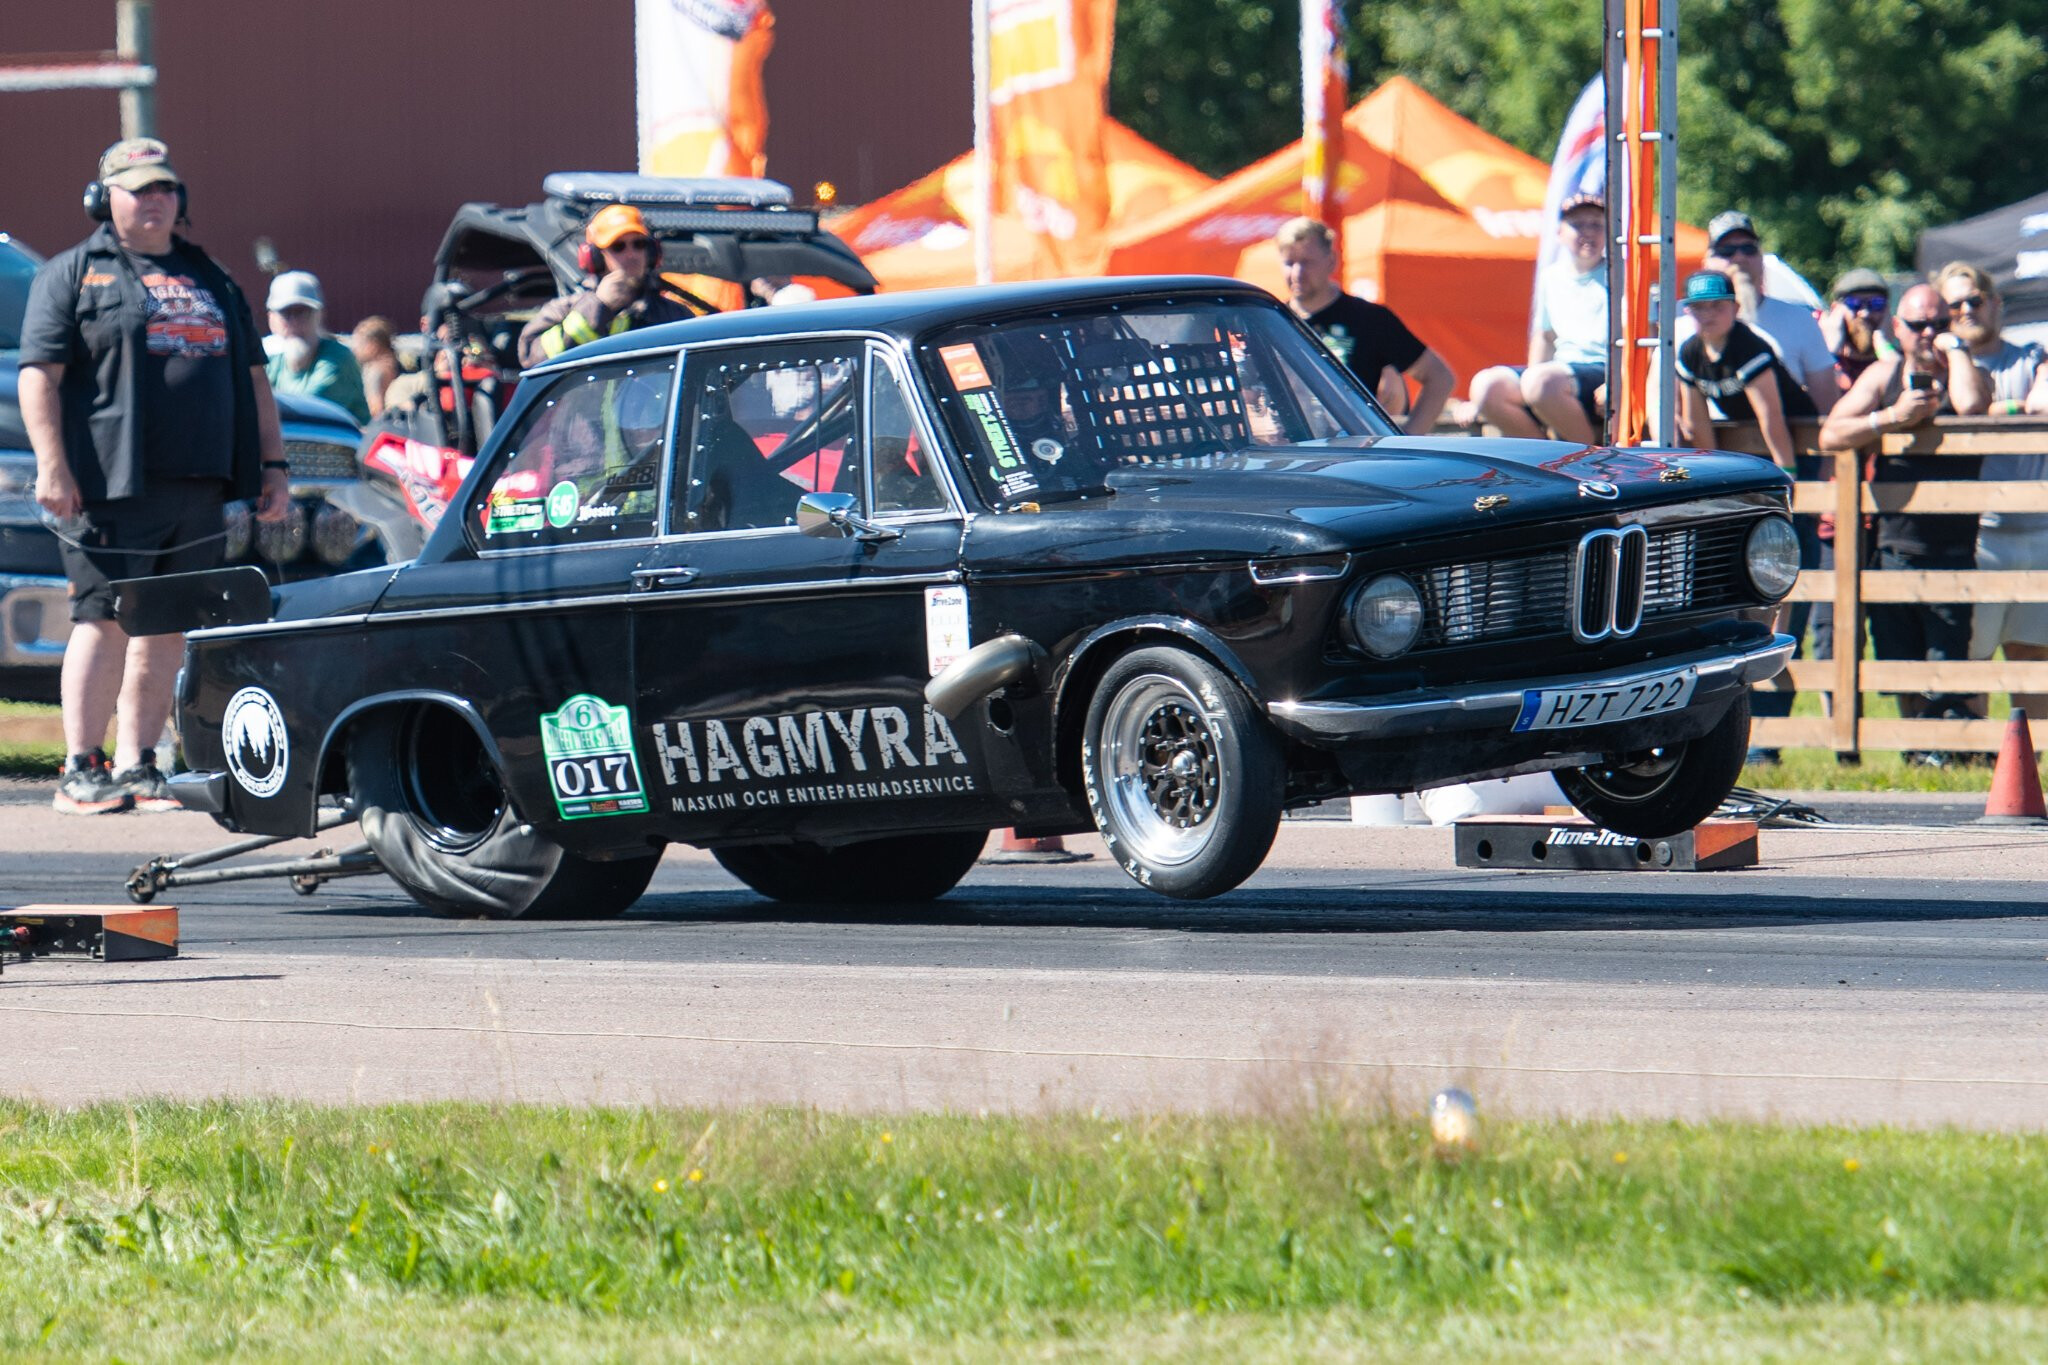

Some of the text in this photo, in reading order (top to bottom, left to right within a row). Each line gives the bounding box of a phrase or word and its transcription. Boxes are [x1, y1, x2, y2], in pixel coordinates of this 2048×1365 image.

[575, 703, 591, 728] 6
[1547, 676, 1684, 725] HZT 722
[652, 703, 968, 785] HAGMYRA
[556, 756, 628, 796] 017
[671, 775, 976, 813] MASKIN OCH ENTREPRENADSERVICE
[1546, 827, 1639, 846] Time-Tree
